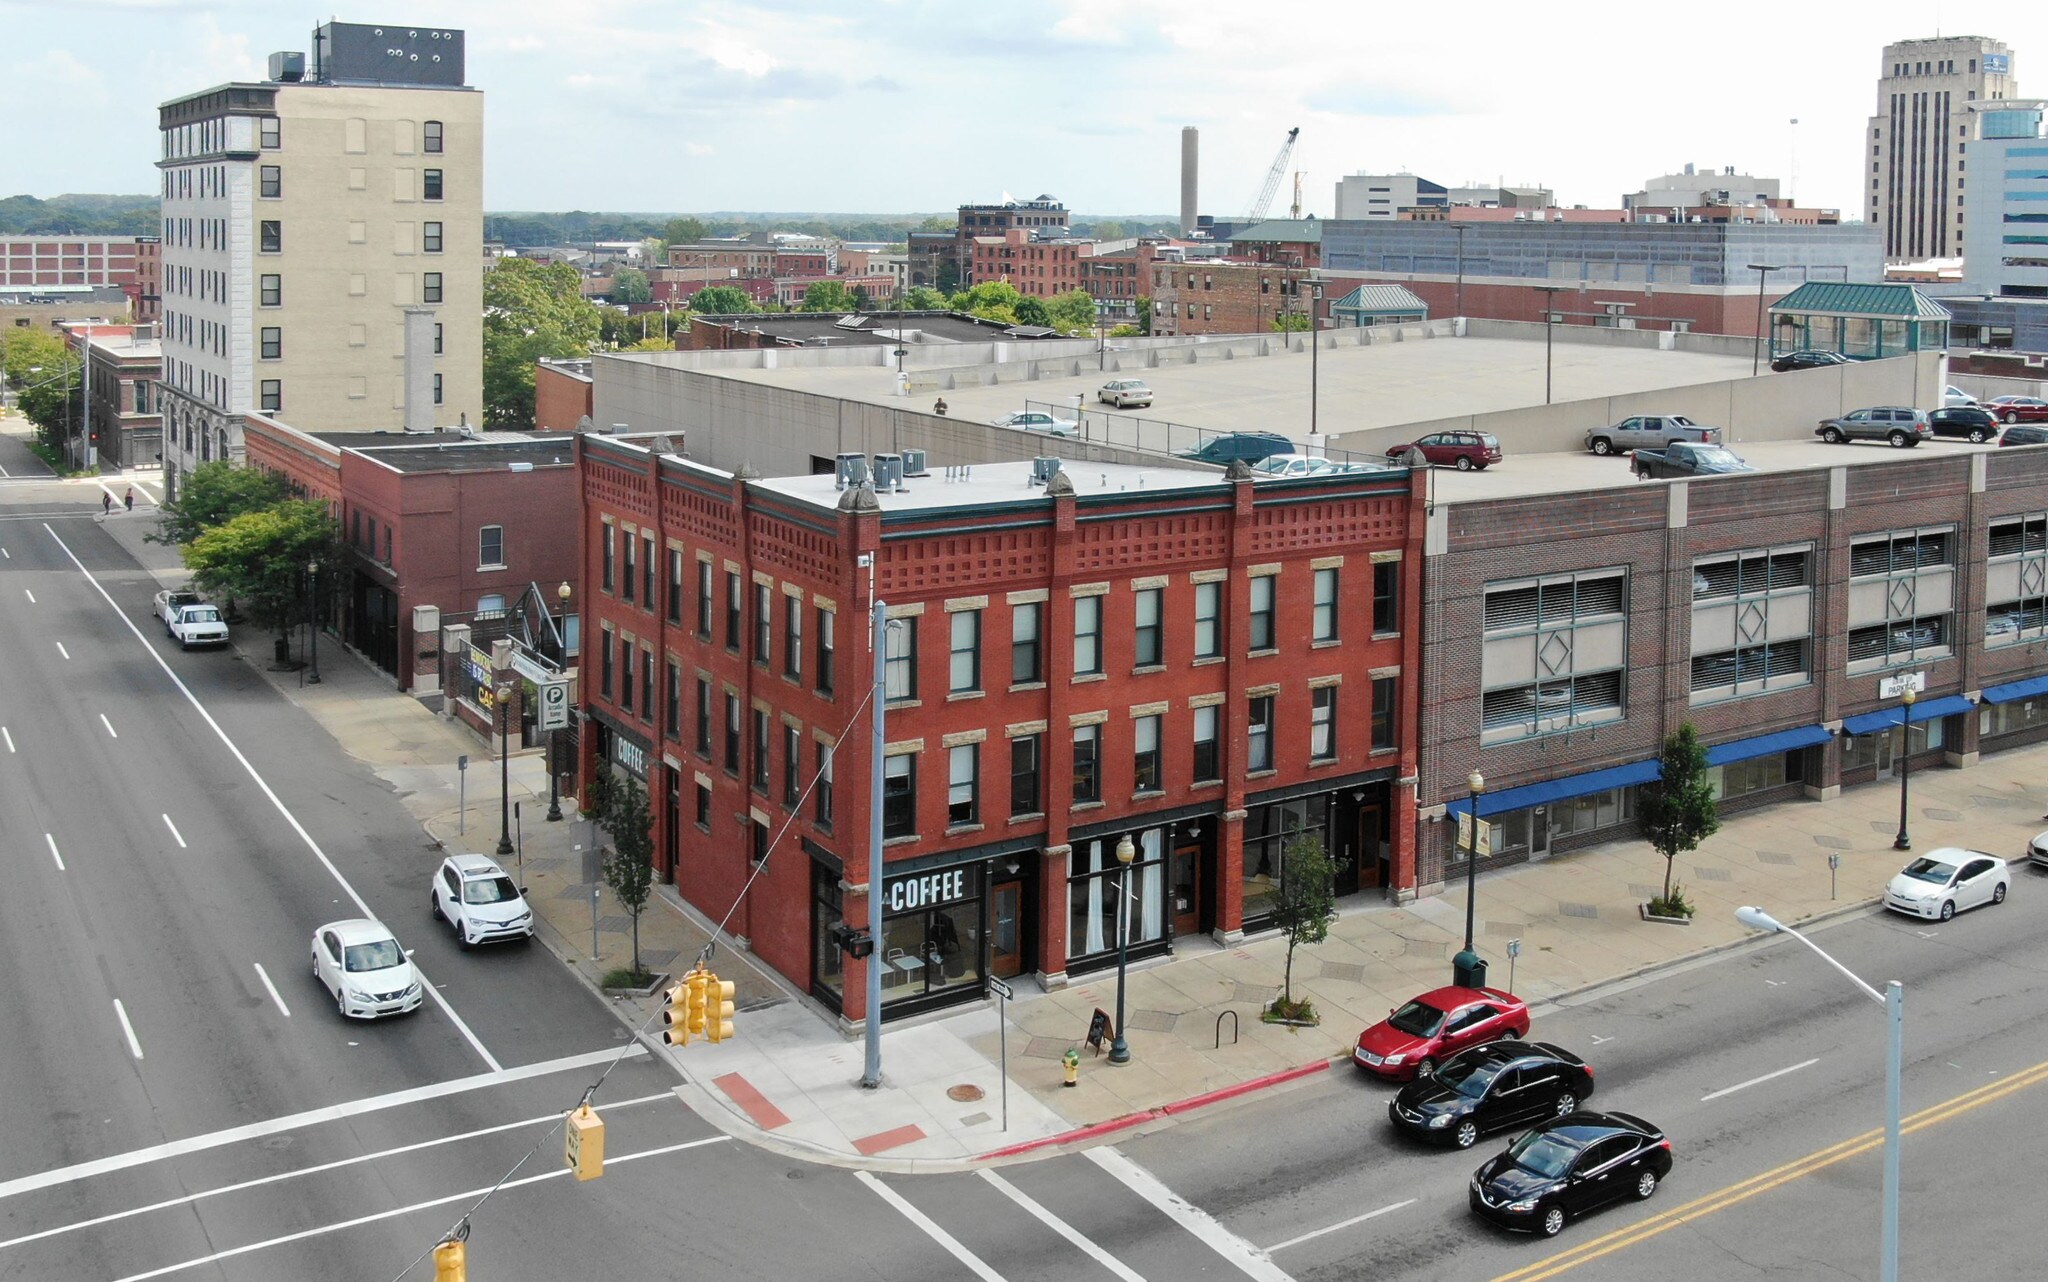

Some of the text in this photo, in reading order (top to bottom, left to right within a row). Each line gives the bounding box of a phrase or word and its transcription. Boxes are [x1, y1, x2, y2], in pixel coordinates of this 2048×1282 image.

[550, 688, 561, 702] P
[1888, 681, 1917, 696] PARKNG
[618, 736, 643, 774] COFFEE
[891, 869, 963, 911] COFFEE
[568, 1122, 578, 1142] ONE
